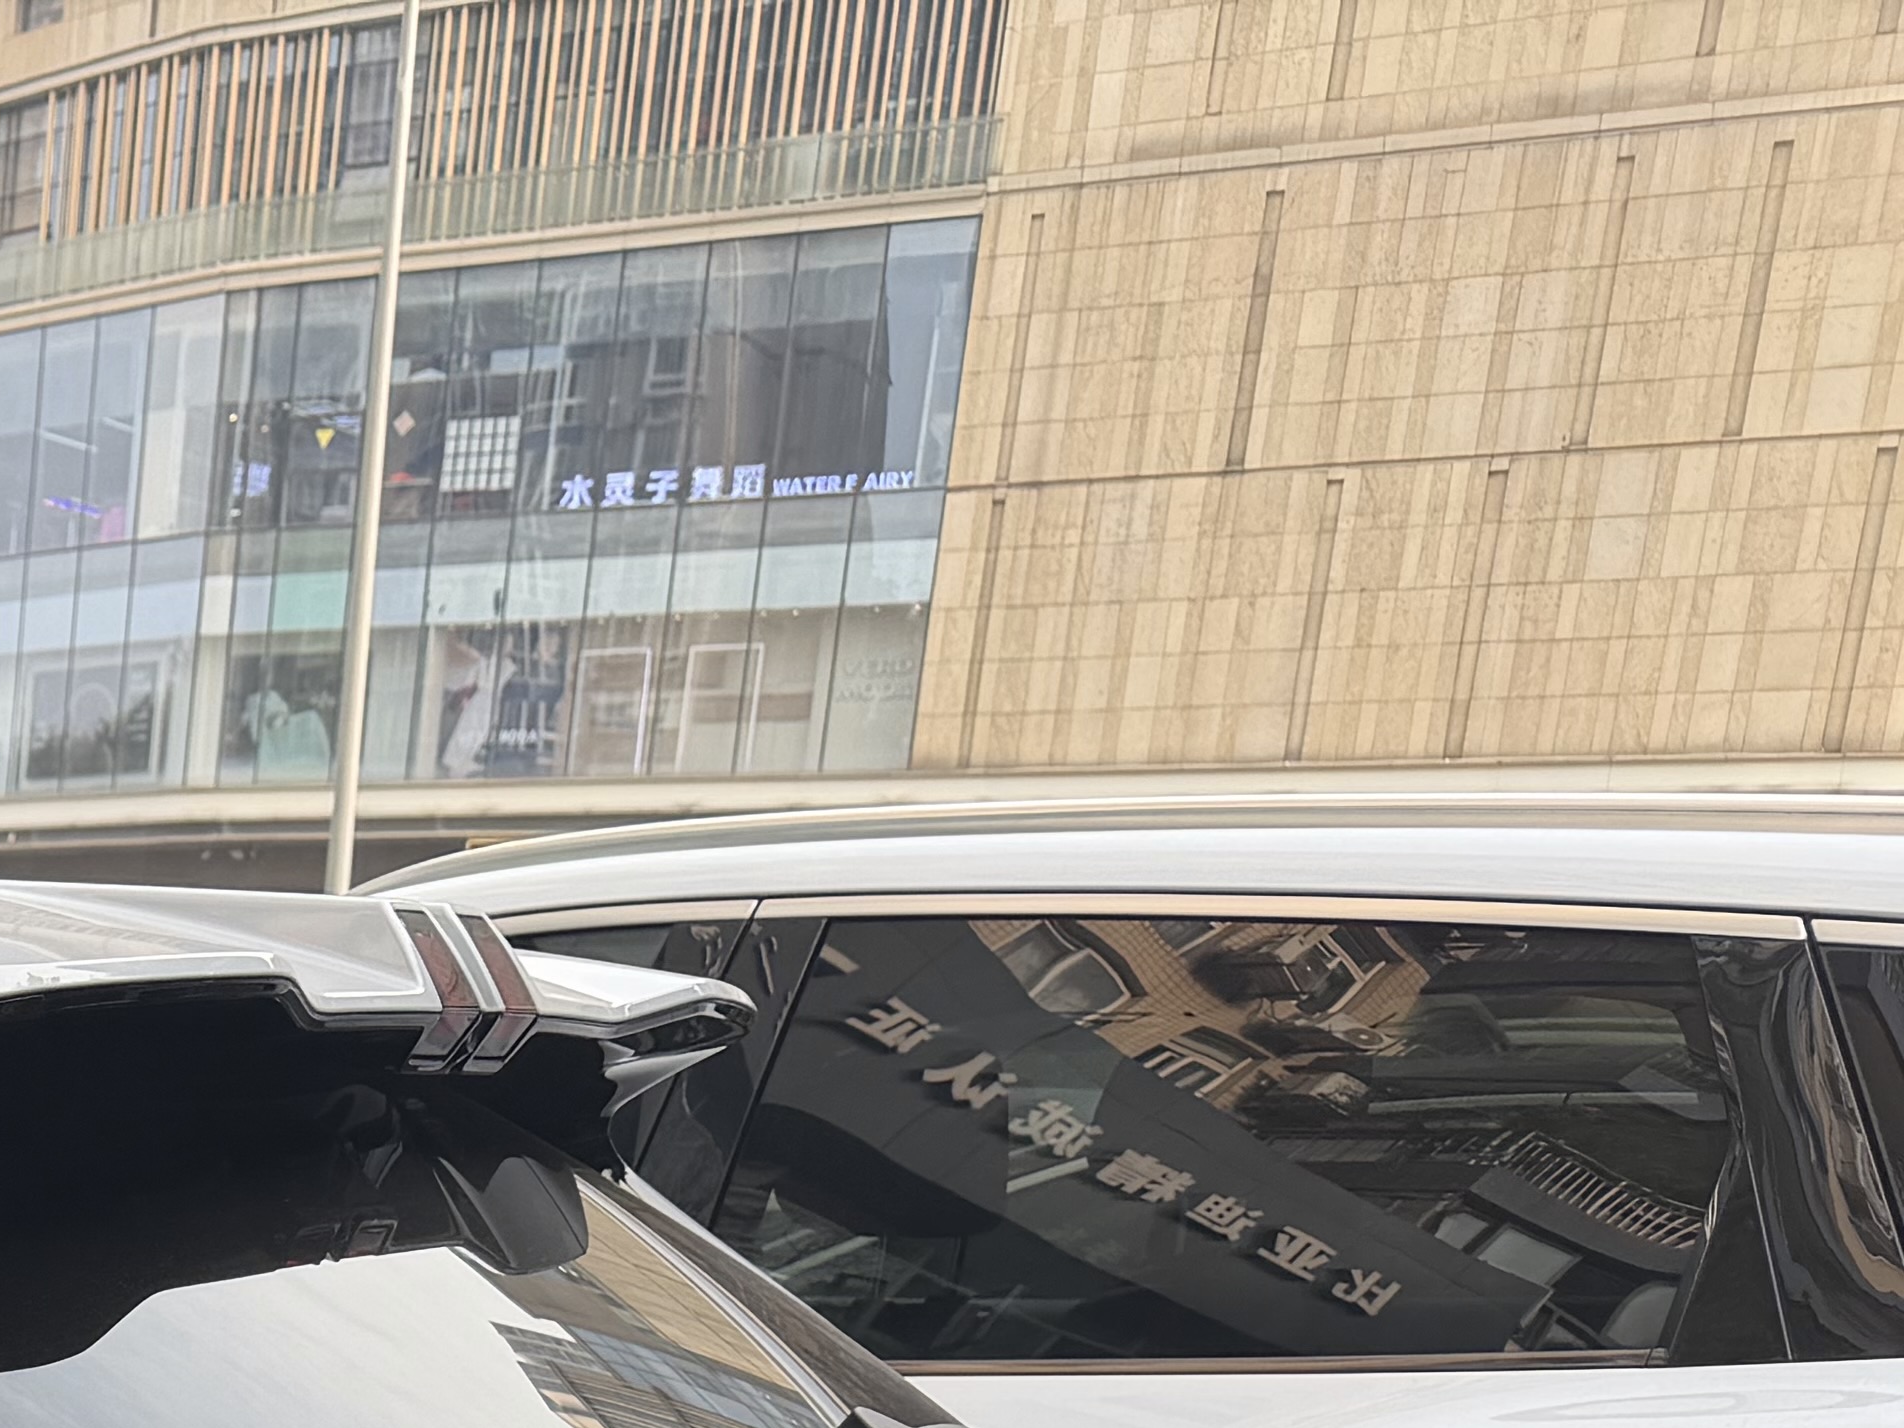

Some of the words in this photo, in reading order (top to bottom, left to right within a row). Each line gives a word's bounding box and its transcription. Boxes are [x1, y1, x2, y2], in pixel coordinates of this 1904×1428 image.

[558, 464, 766, 509] 水灵子舞蹈
